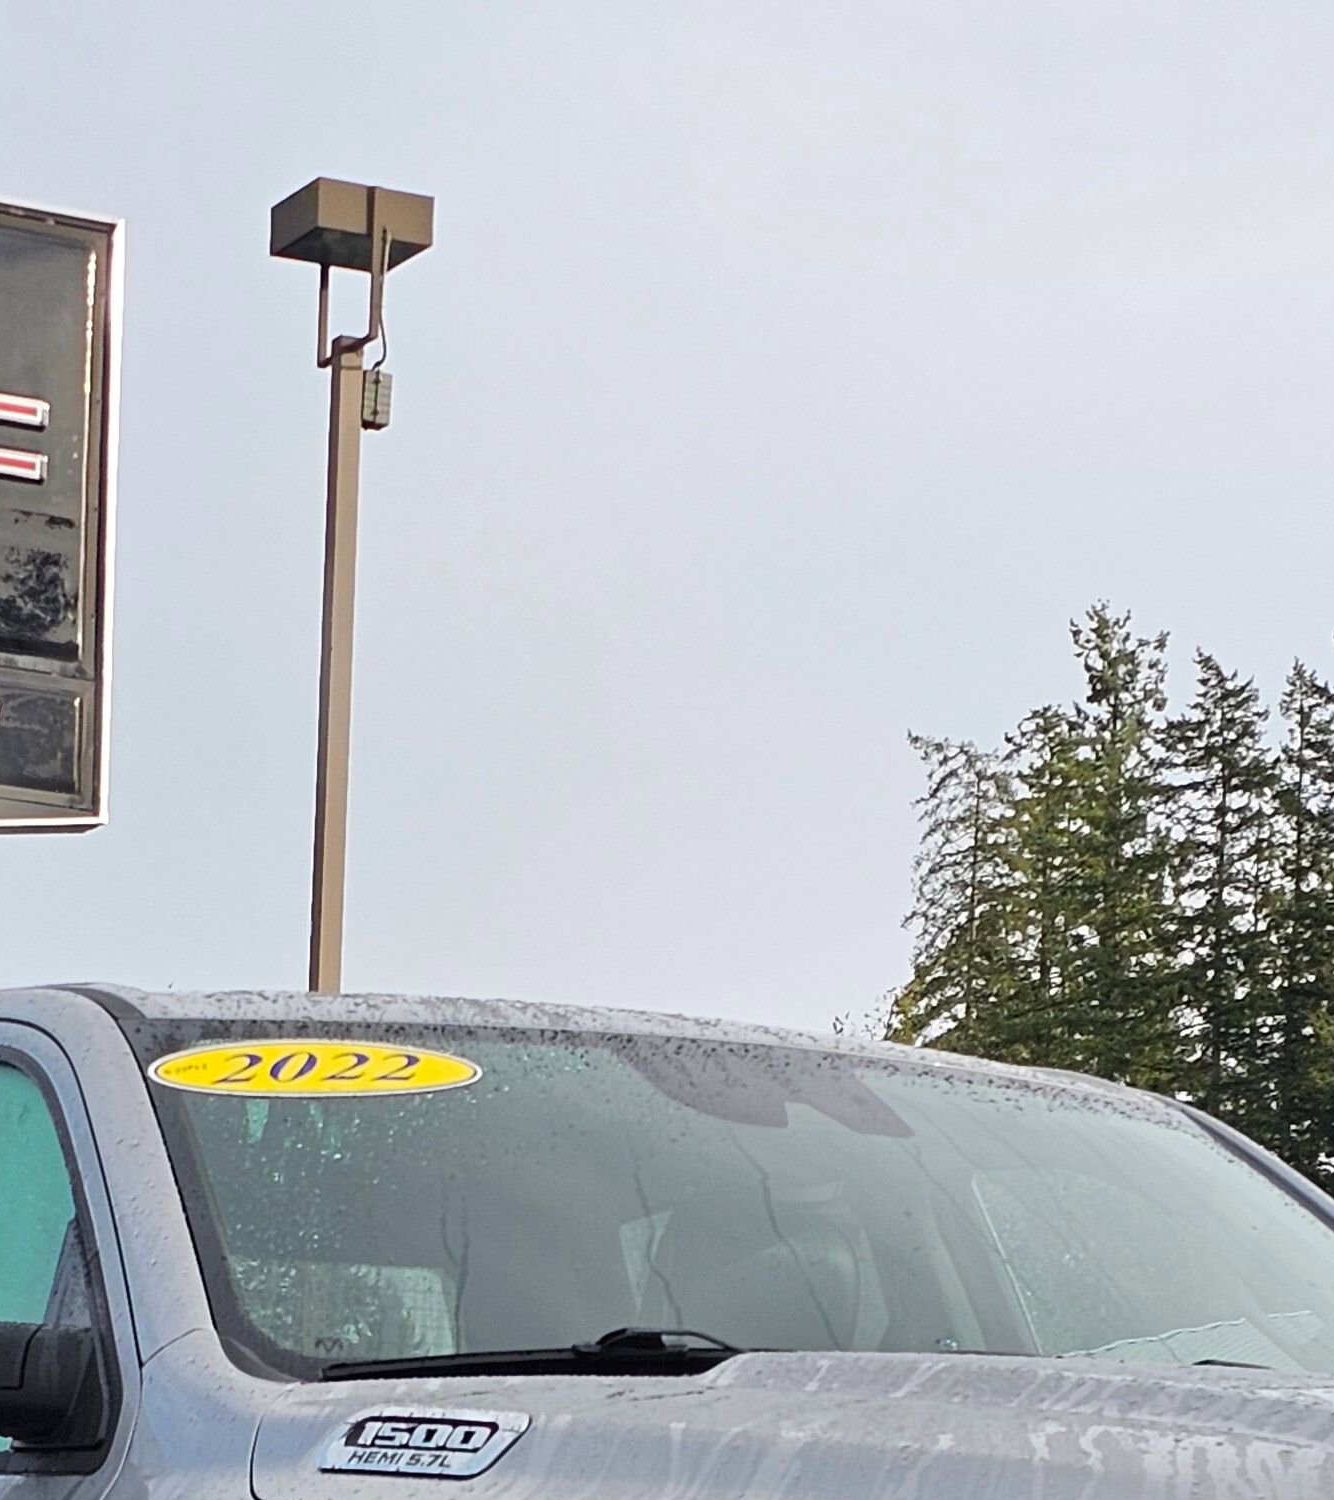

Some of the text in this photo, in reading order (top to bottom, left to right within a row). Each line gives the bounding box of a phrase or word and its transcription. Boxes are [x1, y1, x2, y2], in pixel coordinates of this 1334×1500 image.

[211, 1051, 421, 1085] 2022
[358, 1421, 491, 1450] 1500
[347, 1450, 451, 1469] HEMI 5.7L
